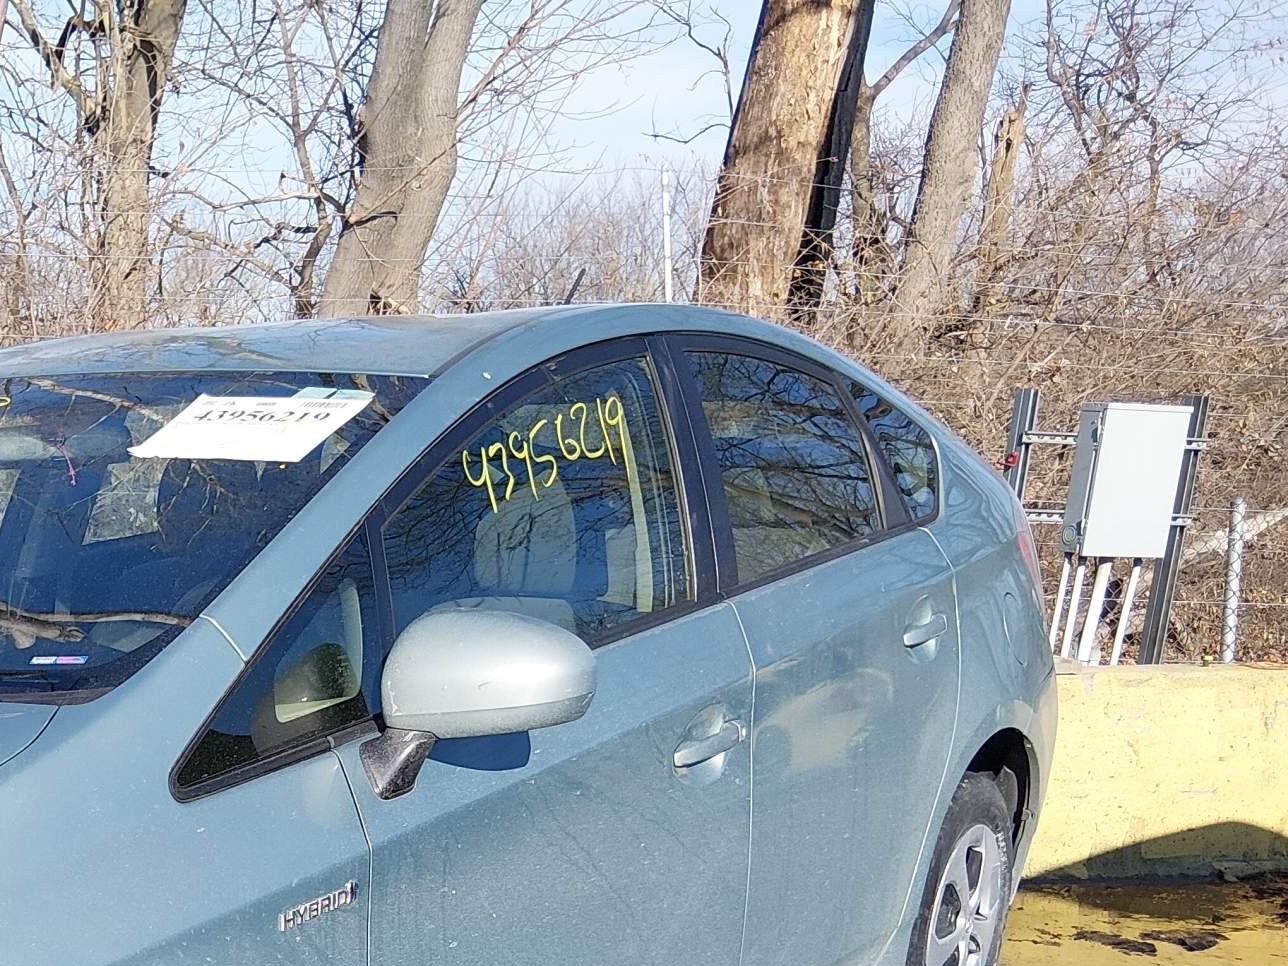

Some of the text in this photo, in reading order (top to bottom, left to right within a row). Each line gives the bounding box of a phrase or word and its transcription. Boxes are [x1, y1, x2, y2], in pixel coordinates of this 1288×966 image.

[193, 409, 332, 423] 43956219
[461, 396, 631, 514] 43956219
[278, 882, 353, 932] HYBRID
